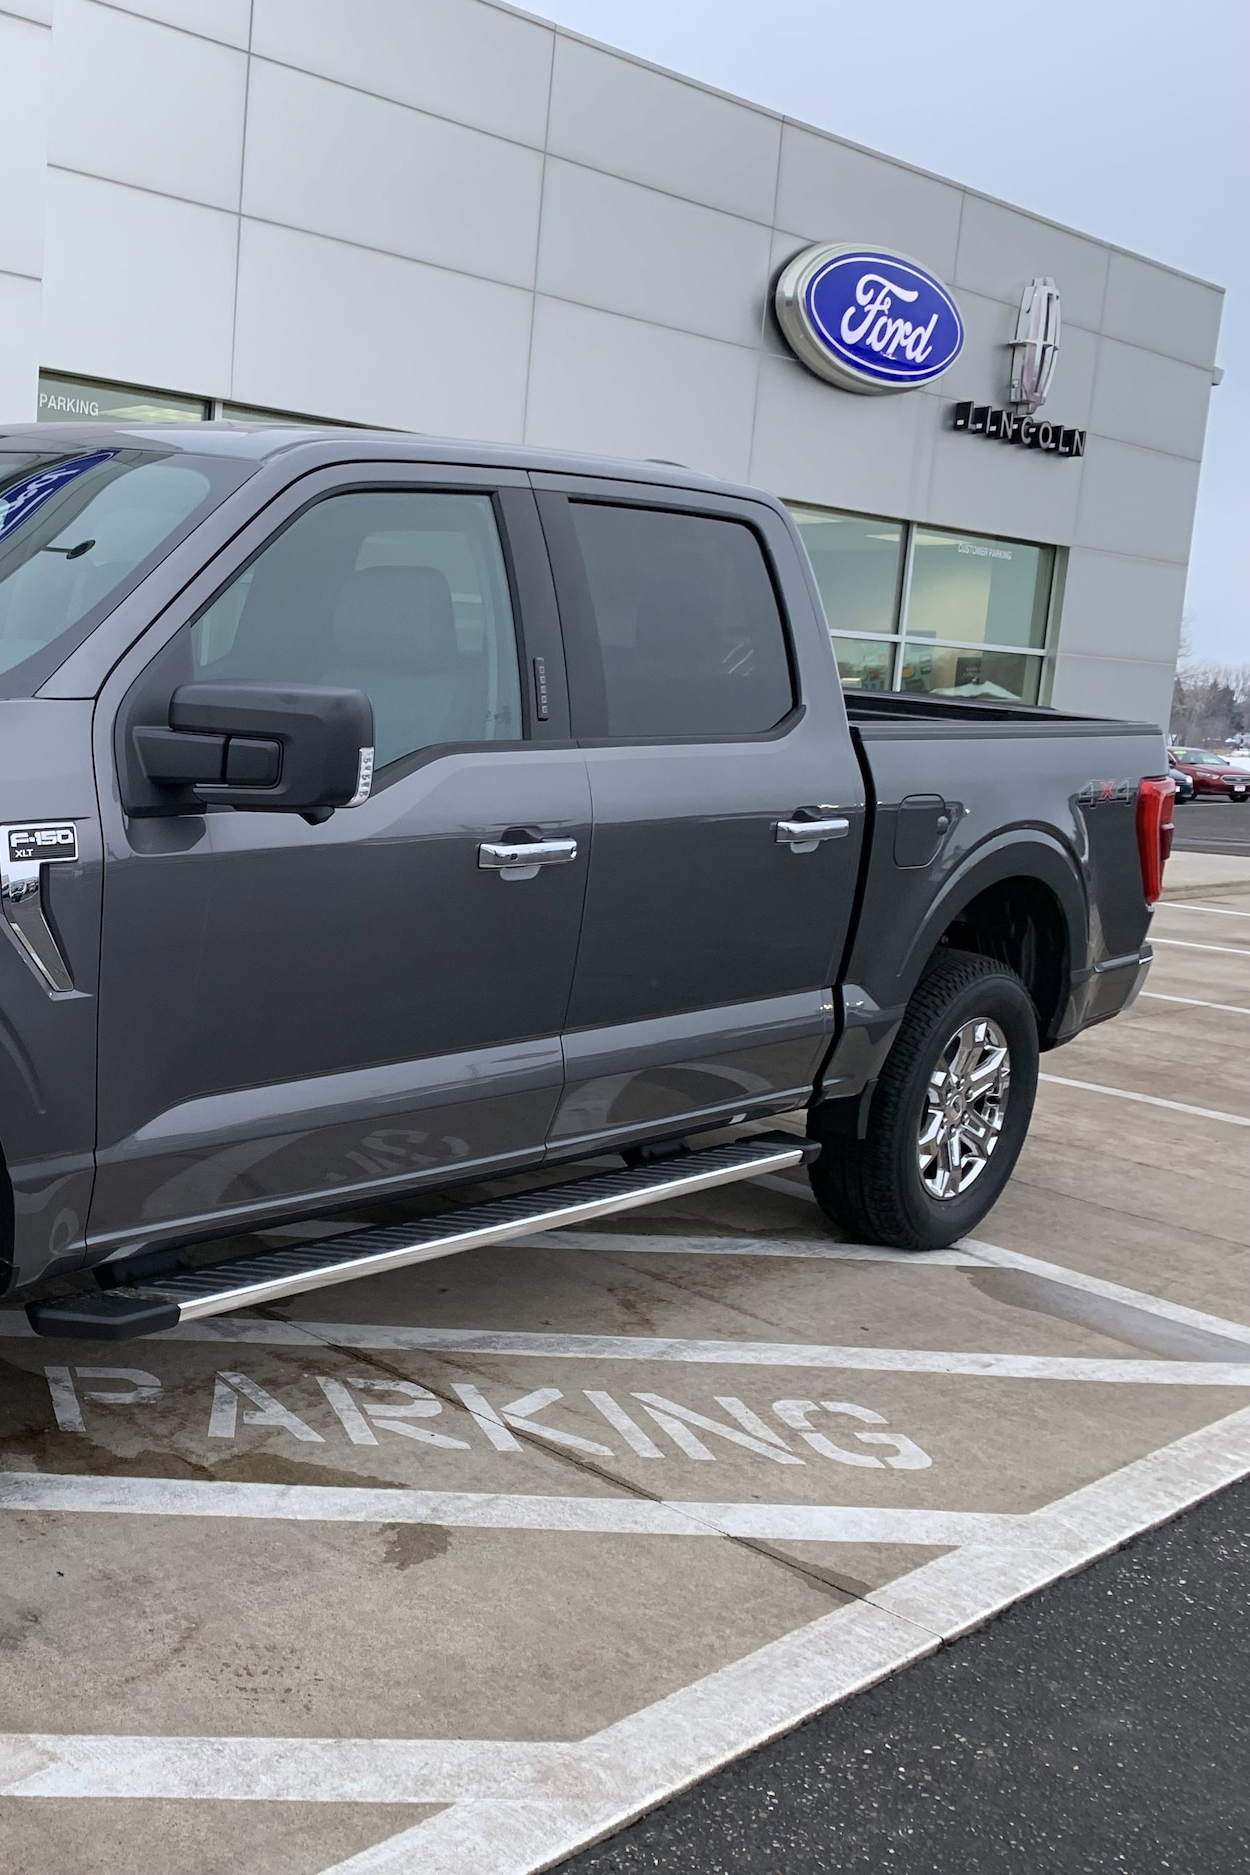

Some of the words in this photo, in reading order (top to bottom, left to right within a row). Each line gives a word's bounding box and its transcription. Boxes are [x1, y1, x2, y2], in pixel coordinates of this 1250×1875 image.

[840, 273, 939, 363] Ford
[39, 393, 99, 416] PARKING
[964, 400, 1087, 457] LINCOLN
[10, 829, 74, 847] F-150
[14, 849, 33, 858] XLT
[43, 1365, 933, 1469] PARKING
